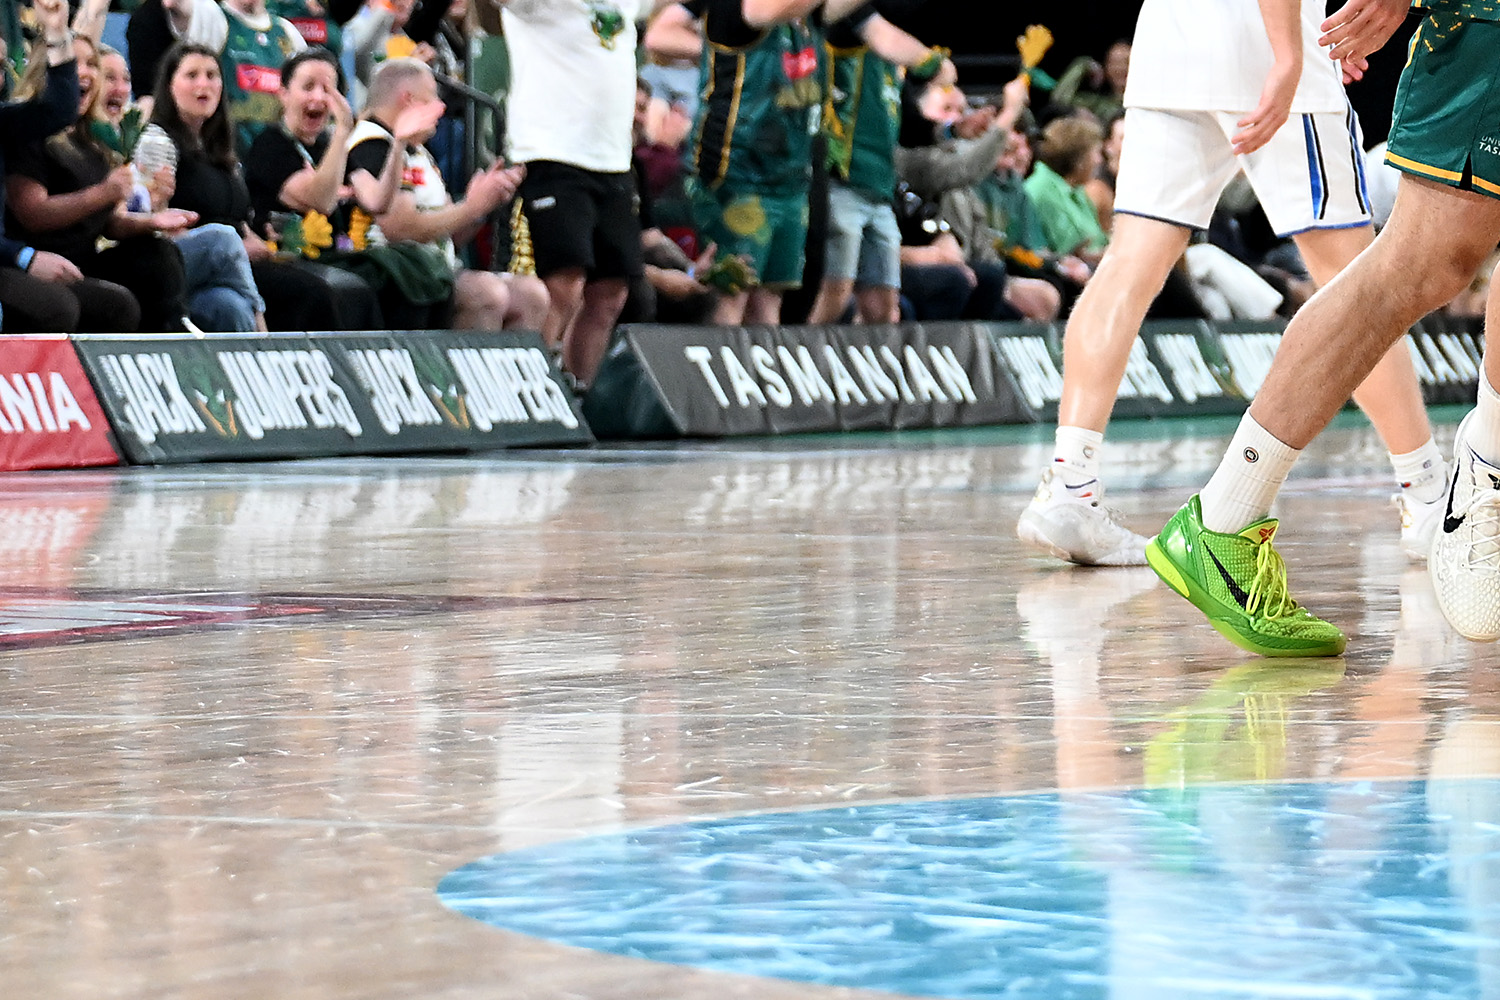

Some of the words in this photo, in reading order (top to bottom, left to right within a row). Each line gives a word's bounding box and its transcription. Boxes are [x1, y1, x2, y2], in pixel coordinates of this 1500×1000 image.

[0, 372, 92, 432] NIA
[113, 352, 207, 444] JACK
[219, 349, 363, 441] JUMPERS
[357, 347, 443, 435] JACK
[447, 346, 579, 432] JUMPERS
[684, 344, 977, 409] TASMANIAN
